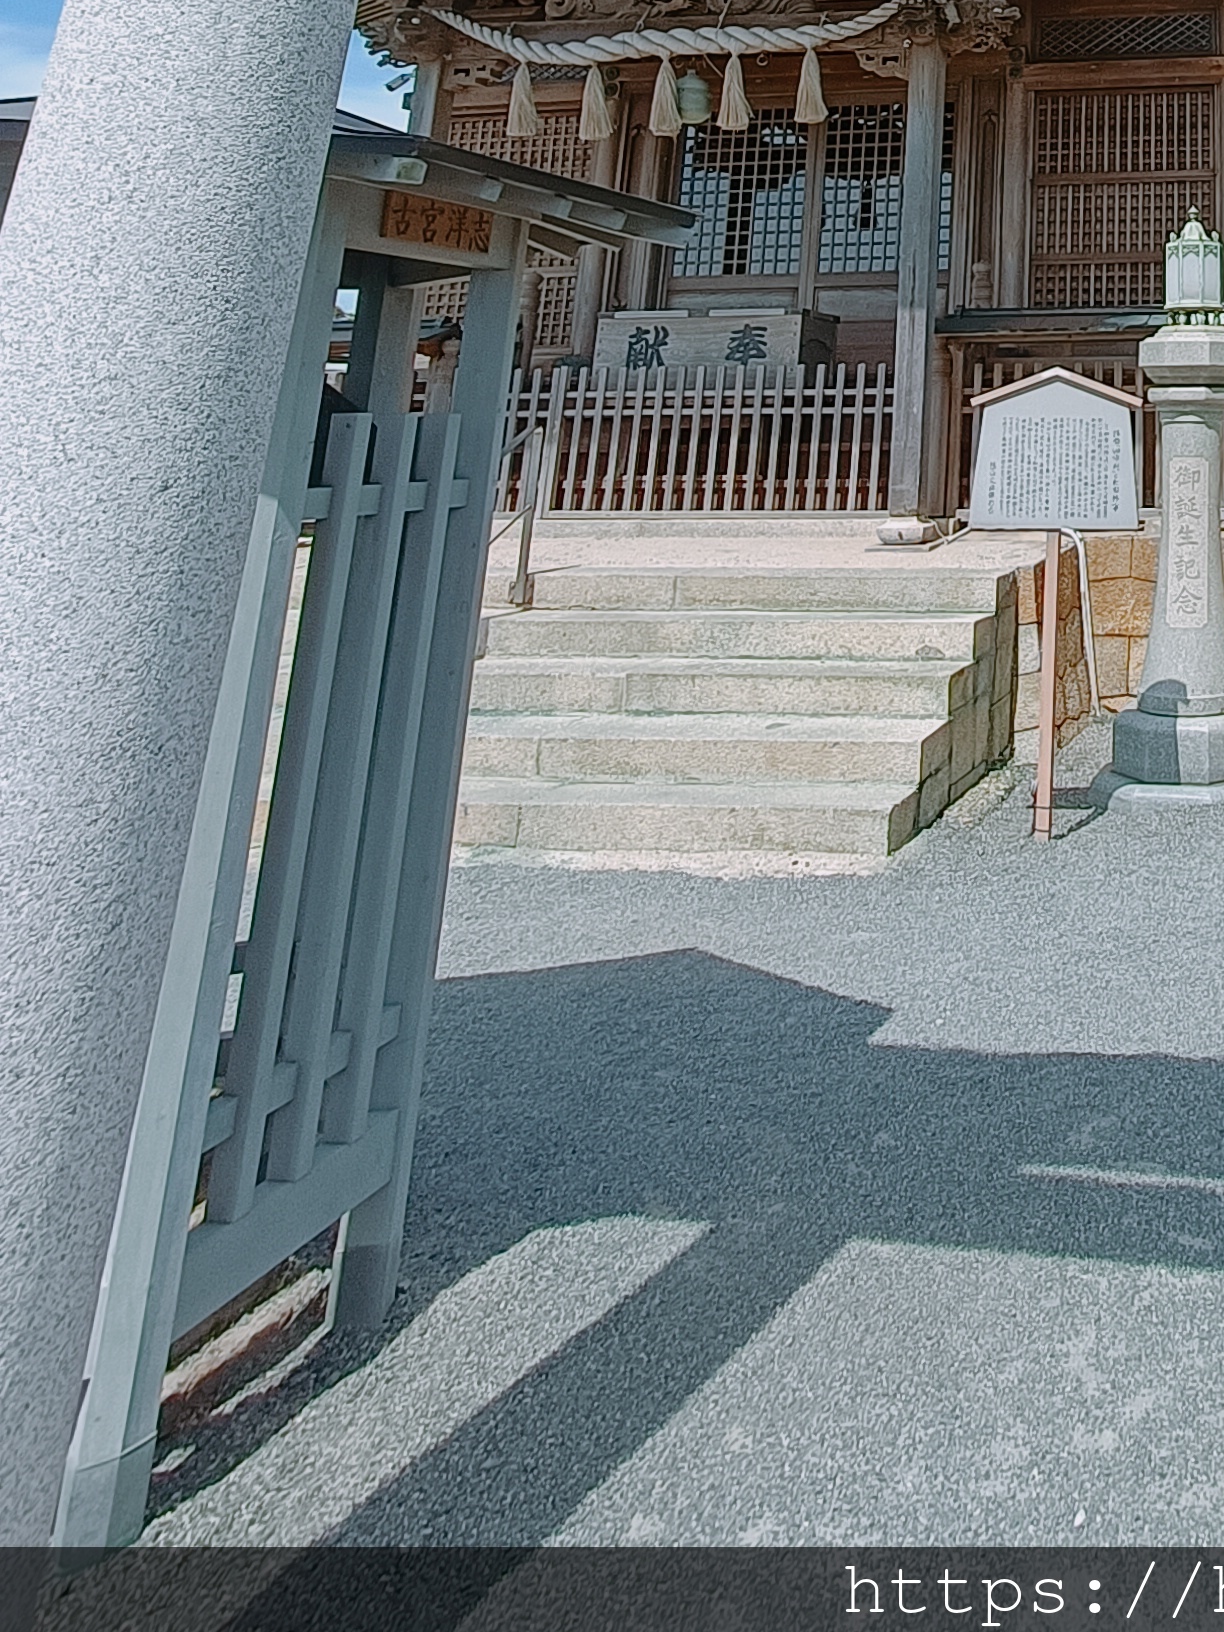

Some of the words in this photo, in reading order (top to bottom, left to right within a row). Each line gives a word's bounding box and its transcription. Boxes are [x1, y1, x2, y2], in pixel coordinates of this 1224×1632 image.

[1172, 465, 1204, 617] 御誕生記念
